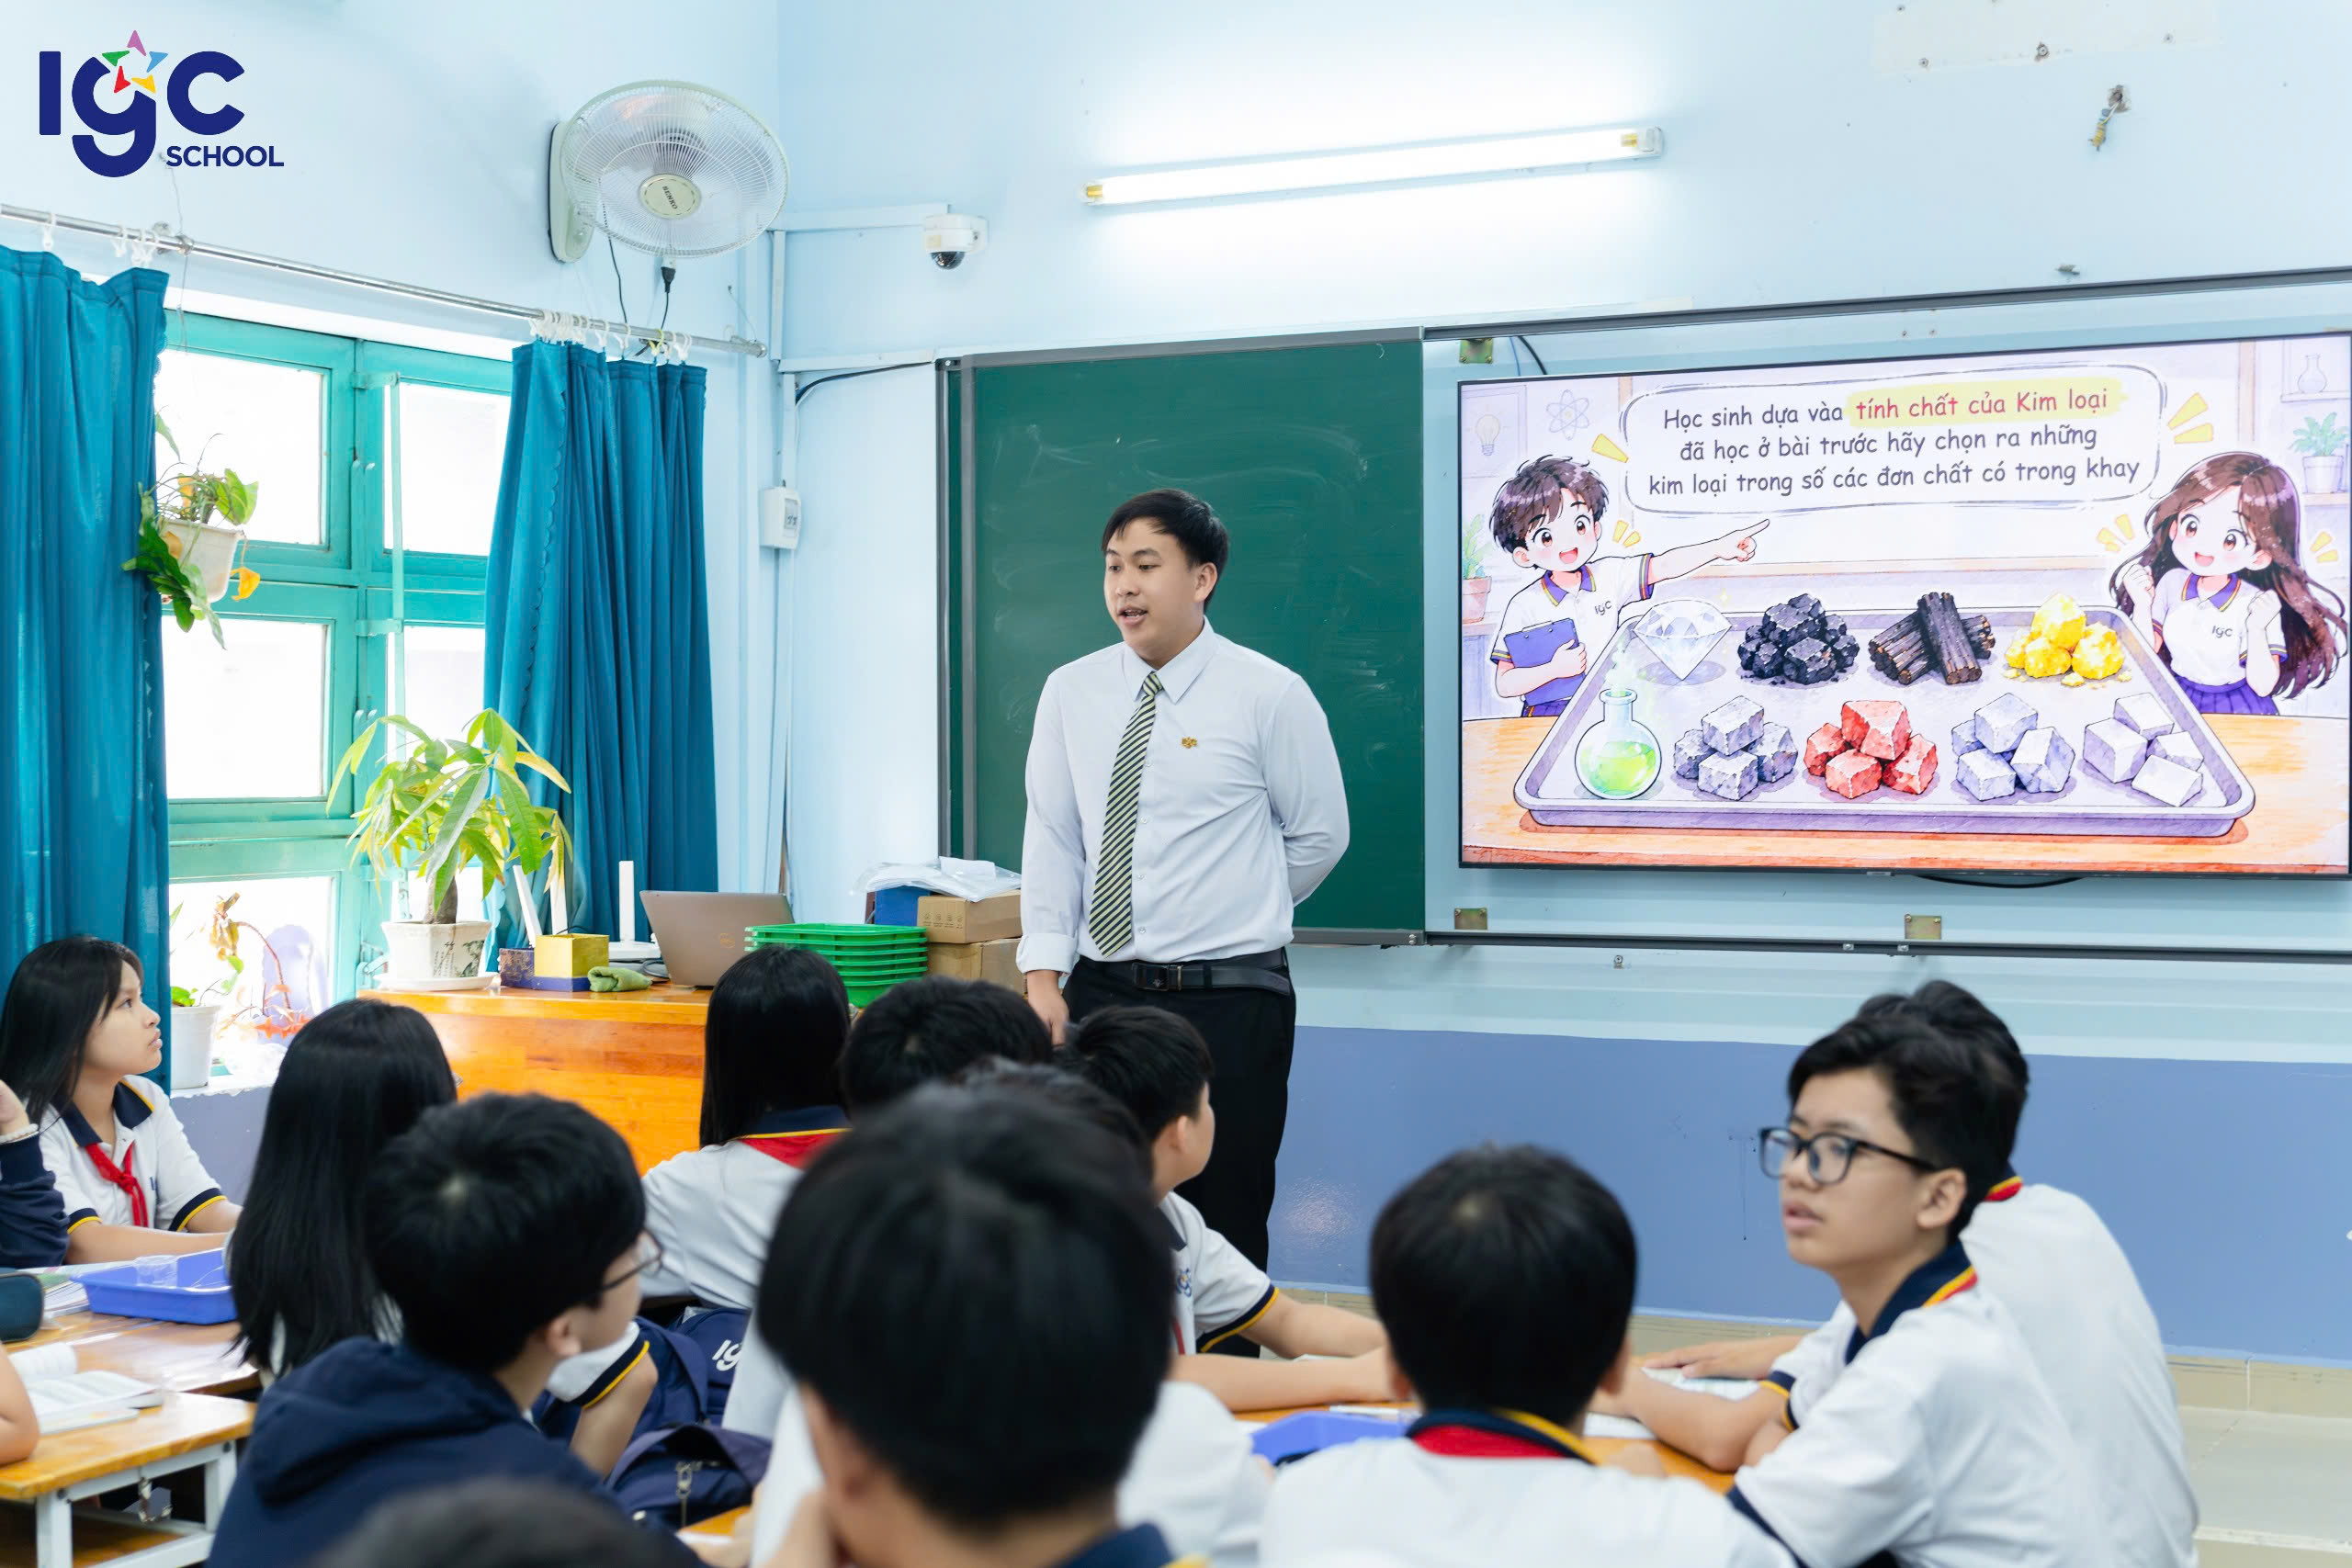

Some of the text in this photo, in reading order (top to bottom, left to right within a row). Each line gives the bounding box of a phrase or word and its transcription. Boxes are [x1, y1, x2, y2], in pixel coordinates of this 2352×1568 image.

[1664, 408, 1703, 434] Học
[1711, 404, 1753, 427] sinh
[1761, 403, 1799, 429] dựa
[1855, 397, 1899, 420] tính
[1908, 392, 1959, 418] chất
[1967, 390, 2007, 415] của
[2017, 391, 2057, 412] Kim
[2068, 388, 2108, 414] loại
[1679, 423, 2098, 464] đã học ở bài trước hãy chọn ra những
[1649, 456, 2141, 498] kim loại trong số các đơn chất có trong khay
[711, 1338, 742, 1371] Ig
